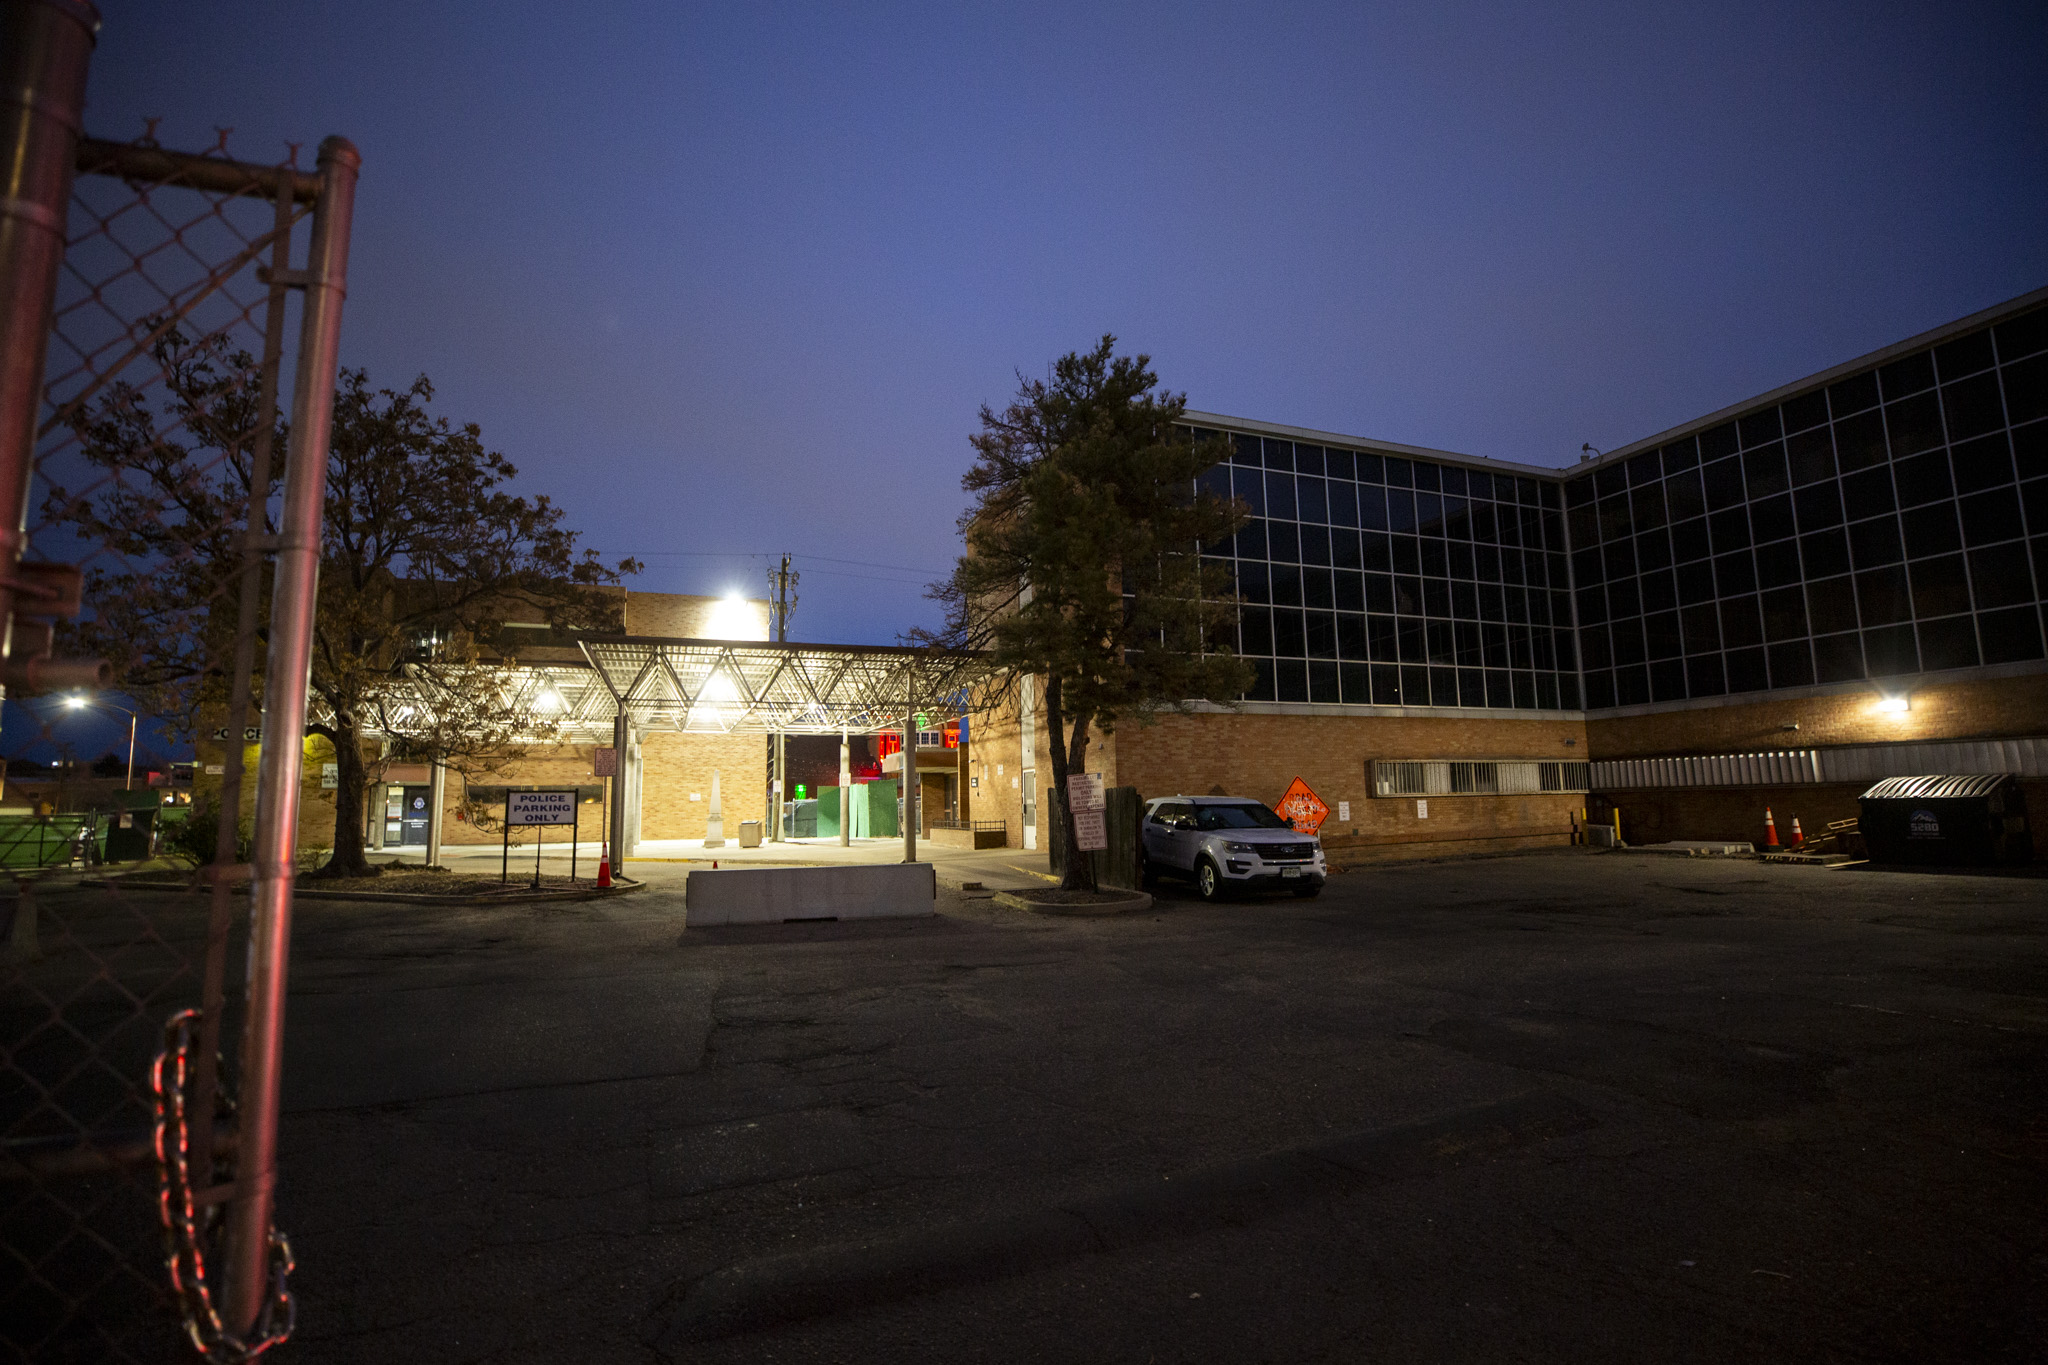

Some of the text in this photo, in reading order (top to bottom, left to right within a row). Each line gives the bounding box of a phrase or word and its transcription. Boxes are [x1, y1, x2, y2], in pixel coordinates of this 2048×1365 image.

[520, 795, 566, 803] POLICE
[1289, 792, 1312, 801] ROAD
[513, 804, 571, 812] PARKING
[525, 814, 559, 822] ONLY
[1293, 820, 1318, 830] HEAD
[1910, 823, 1940, 832] 5280
